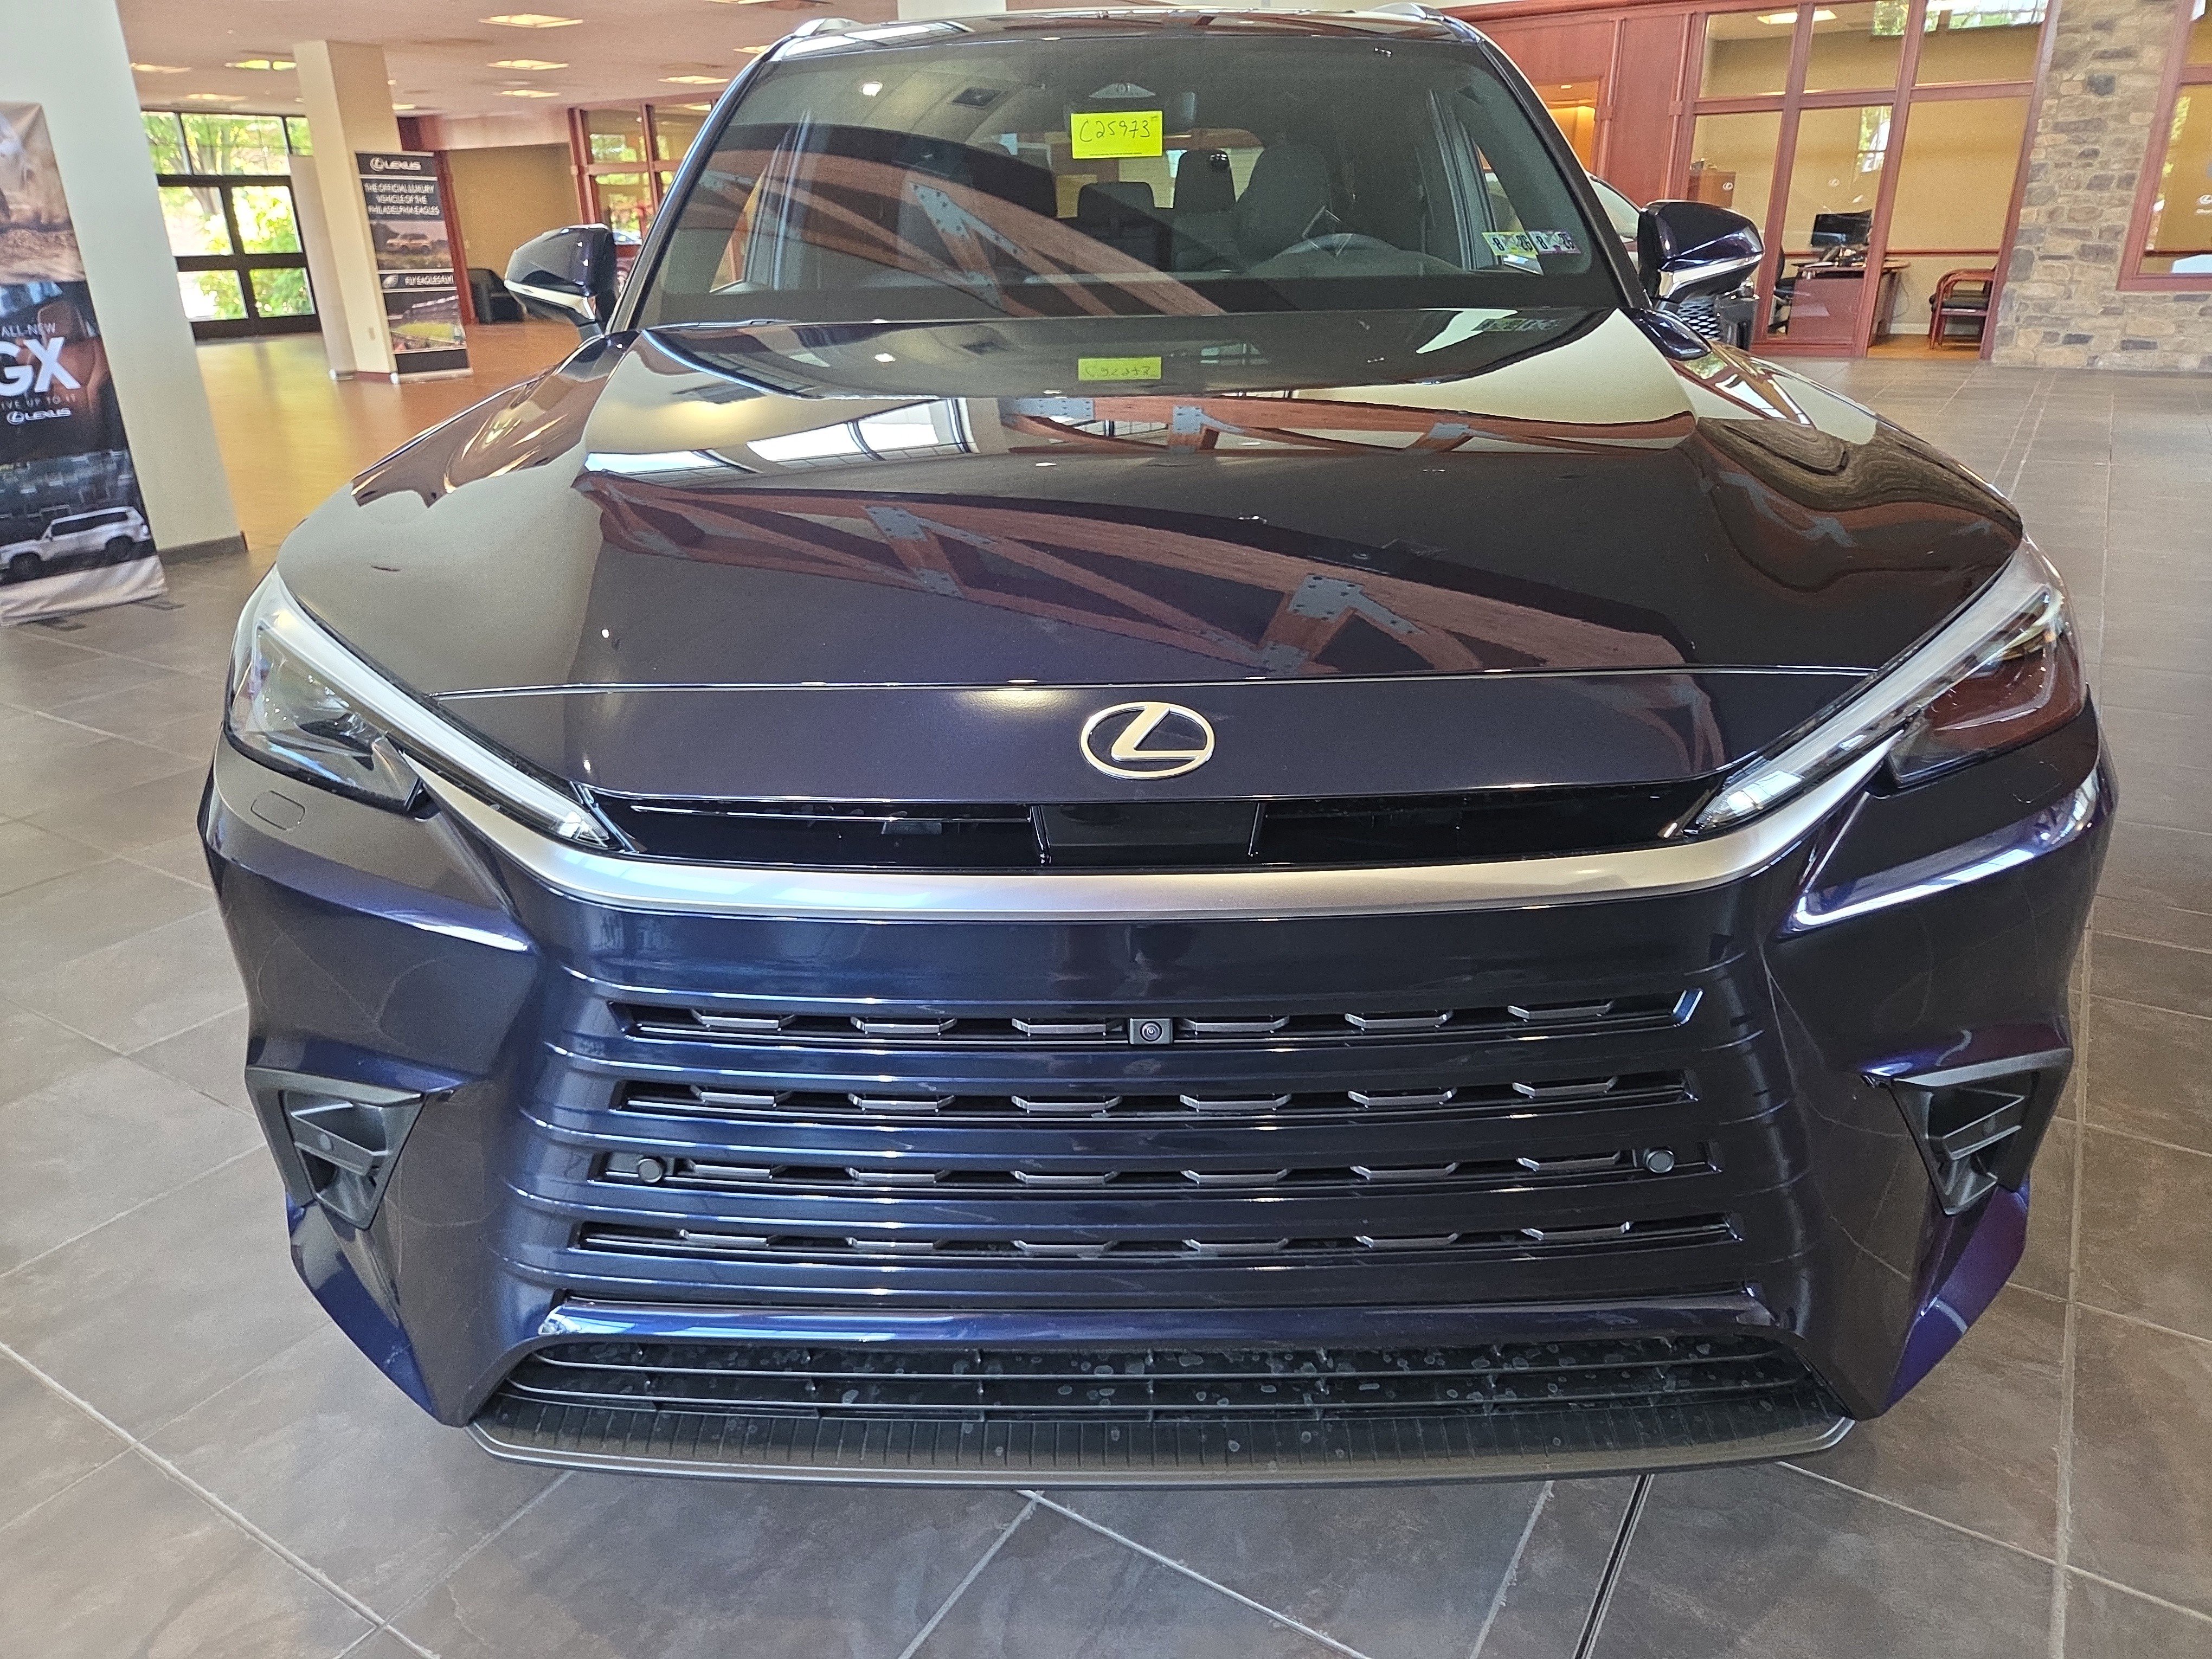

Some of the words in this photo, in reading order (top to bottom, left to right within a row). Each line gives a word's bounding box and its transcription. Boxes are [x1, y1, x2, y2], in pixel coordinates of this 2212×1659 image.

[1080, 119, 1150, 142] C25973
[385, 160, 421, 170] LEXUS
[1493, 237, 1505, 251] 8
[1536, 236, 1548, 249] 8
[0, 337, 81, 396] GX
[25, 408, 72, 421] LEXUS
